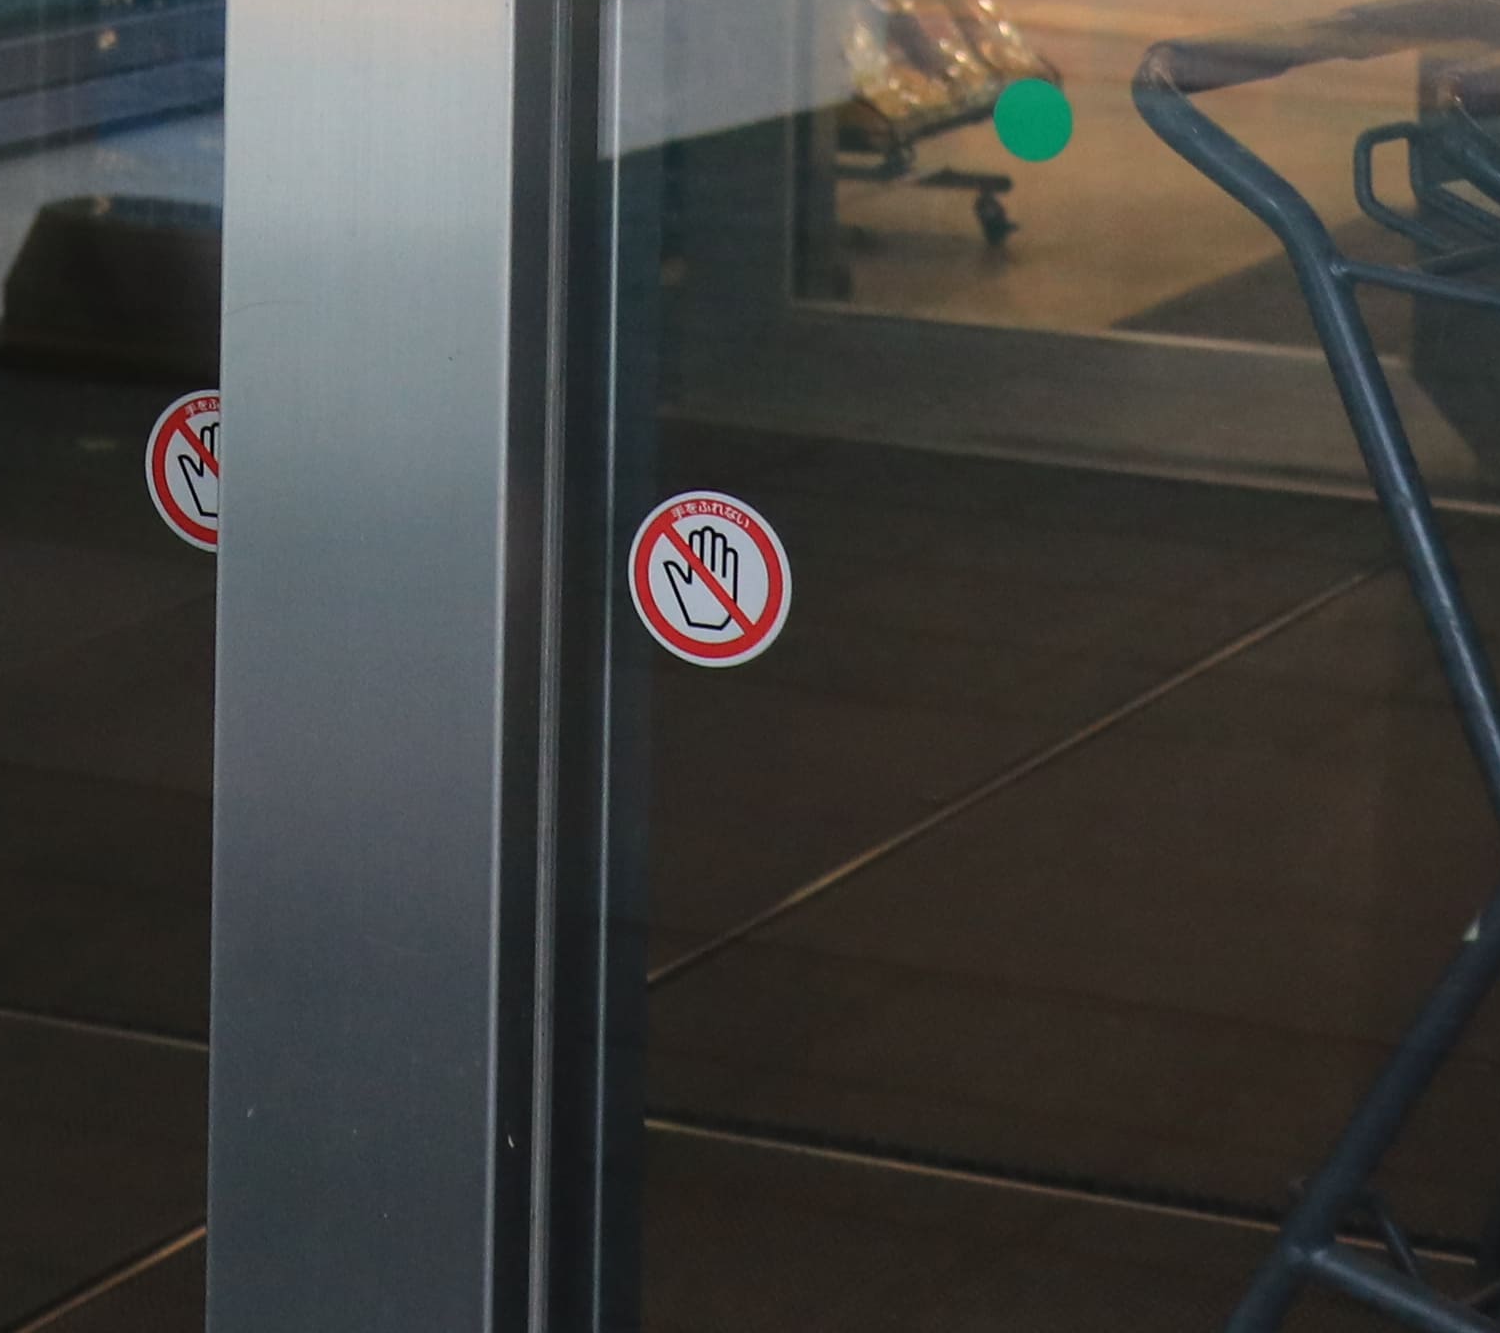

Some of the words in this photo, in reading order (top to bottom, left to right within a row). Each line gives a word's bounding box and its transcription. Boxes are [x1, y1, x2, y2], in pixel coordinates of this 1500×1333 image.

[670, 500, 751, 529] 手をふれない
